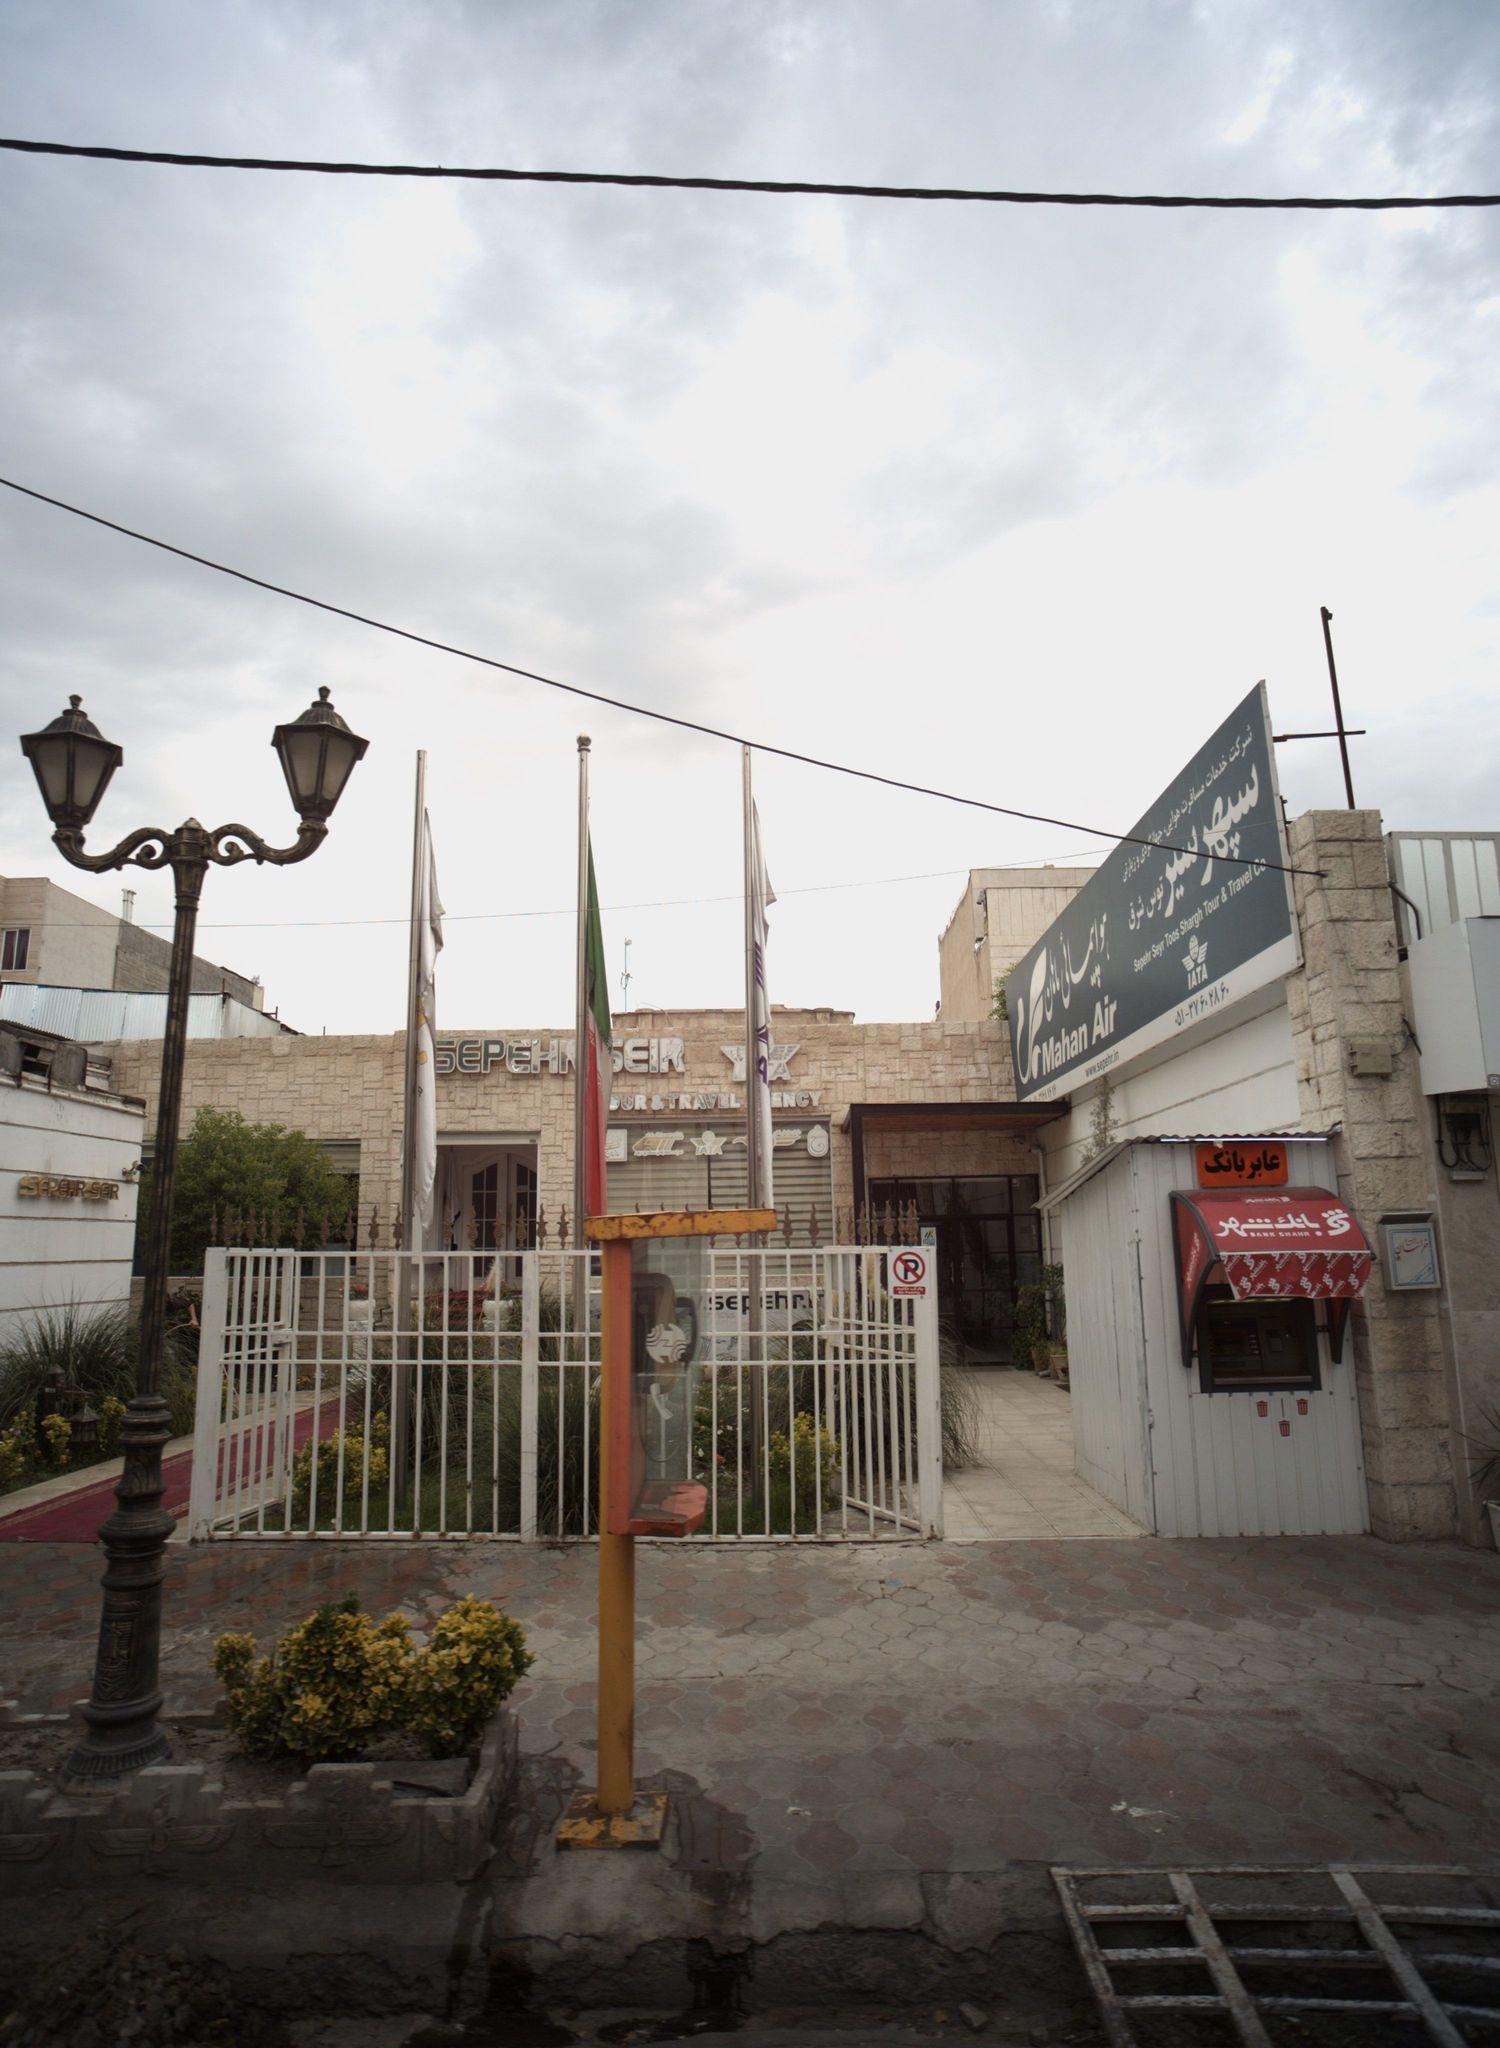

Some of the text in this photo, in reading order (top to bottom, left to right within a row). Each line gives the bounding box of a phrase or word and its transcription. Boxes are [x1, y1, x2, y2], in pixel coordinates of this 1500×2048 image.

[1229, 723, 1253, 763] شرکت
[1205, 754, 1228, 787] خدمات
[1200, 763, 1259, 886] سپهر
[1164, 824, 1199, 918] سیر
[1164, 927, 1180, 947] Toos
[1179, 907, 1204, 936] Shargh
[1203, 893, 1220, 916] Tour
[1221, 886, 1228, 902] &
[1227, 864, 1253, 897] Travel
[1187, 962, 1209, 990] IATA
[1041, 994, 1118, 1077] Mahan Air
[667, 1093, 740, 1112] TRAVEL
[769, 1092, 820, 1109] ENCY
[1204, 1150, 1281, 1180] عابر بانک
[1215, 1216, 1275, 1238] شهر
